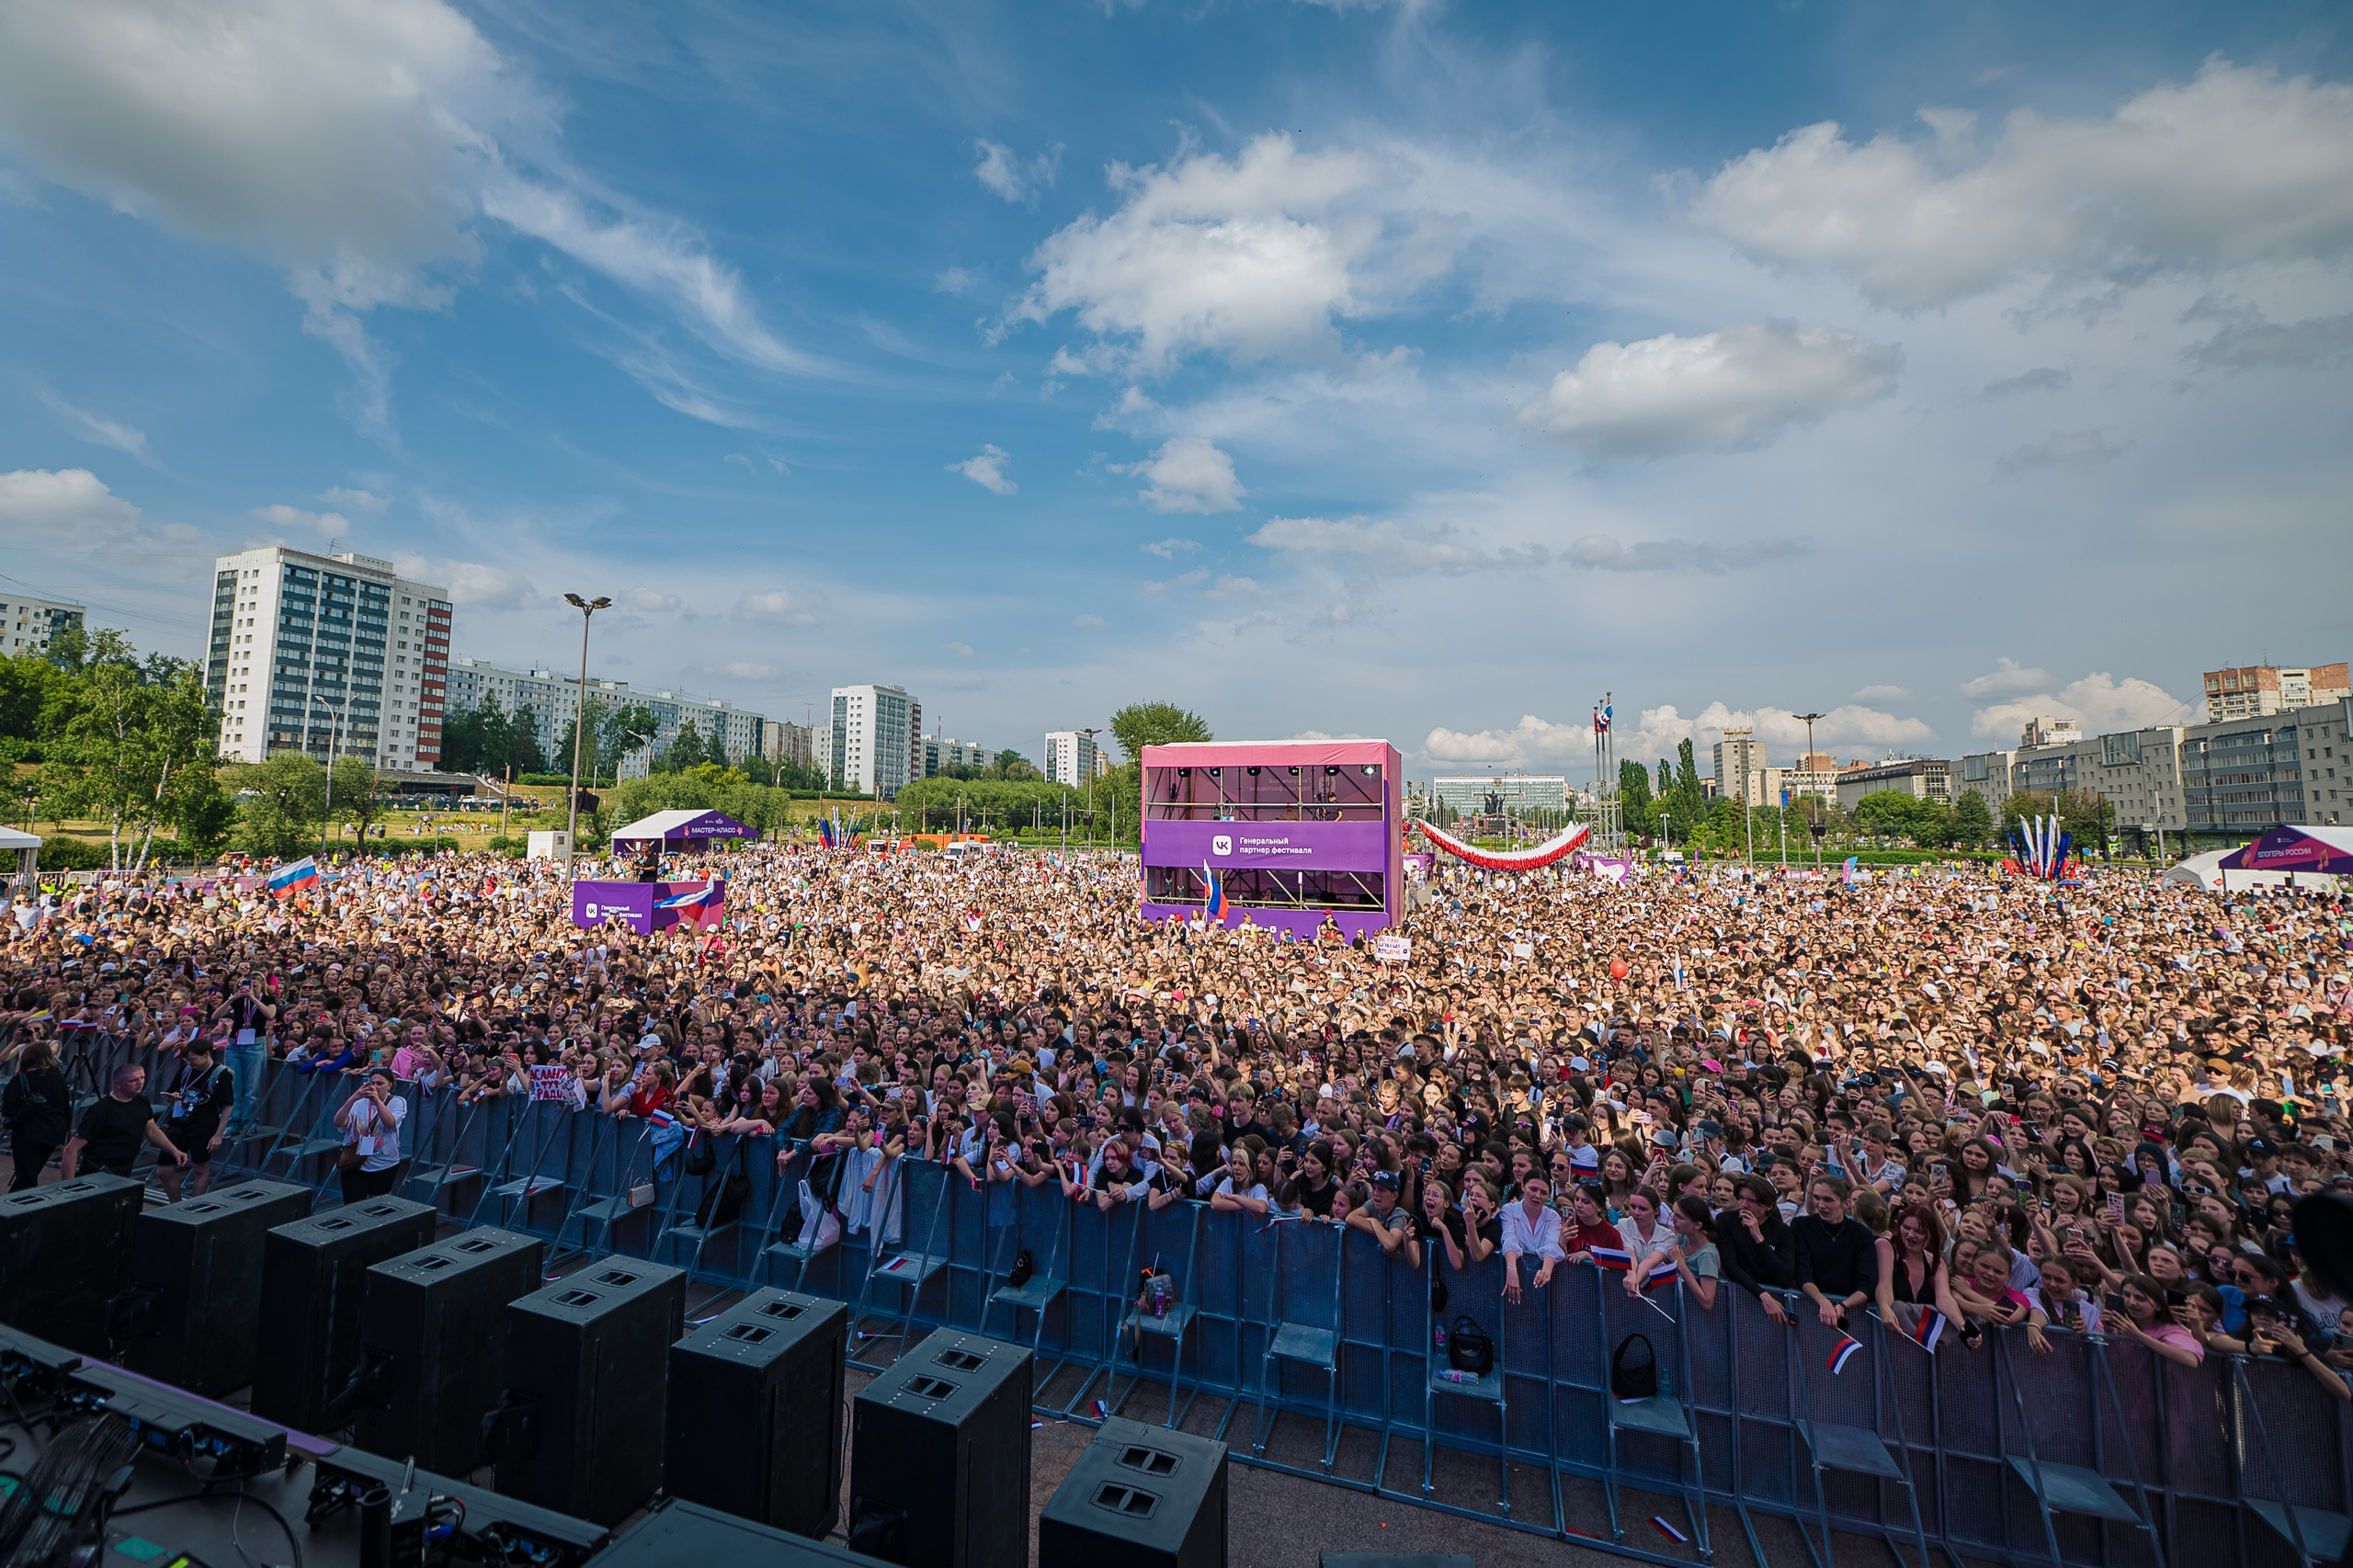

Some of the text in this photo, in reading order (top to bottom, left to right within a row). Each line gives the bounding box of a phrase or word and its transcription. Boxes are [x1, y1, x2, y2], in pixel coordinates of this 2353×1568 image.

[1239, 836, 1289, 846] Генеральный
[1239, 846, 1313, 855] партнер фестиваля
[2257, 847, 2312, 858] БЛОГЕРЫ РОССИИ
[529, 1068, 567, 1081] АСЛАНУ
[540, 1080, 560, 1089] ТУТ
